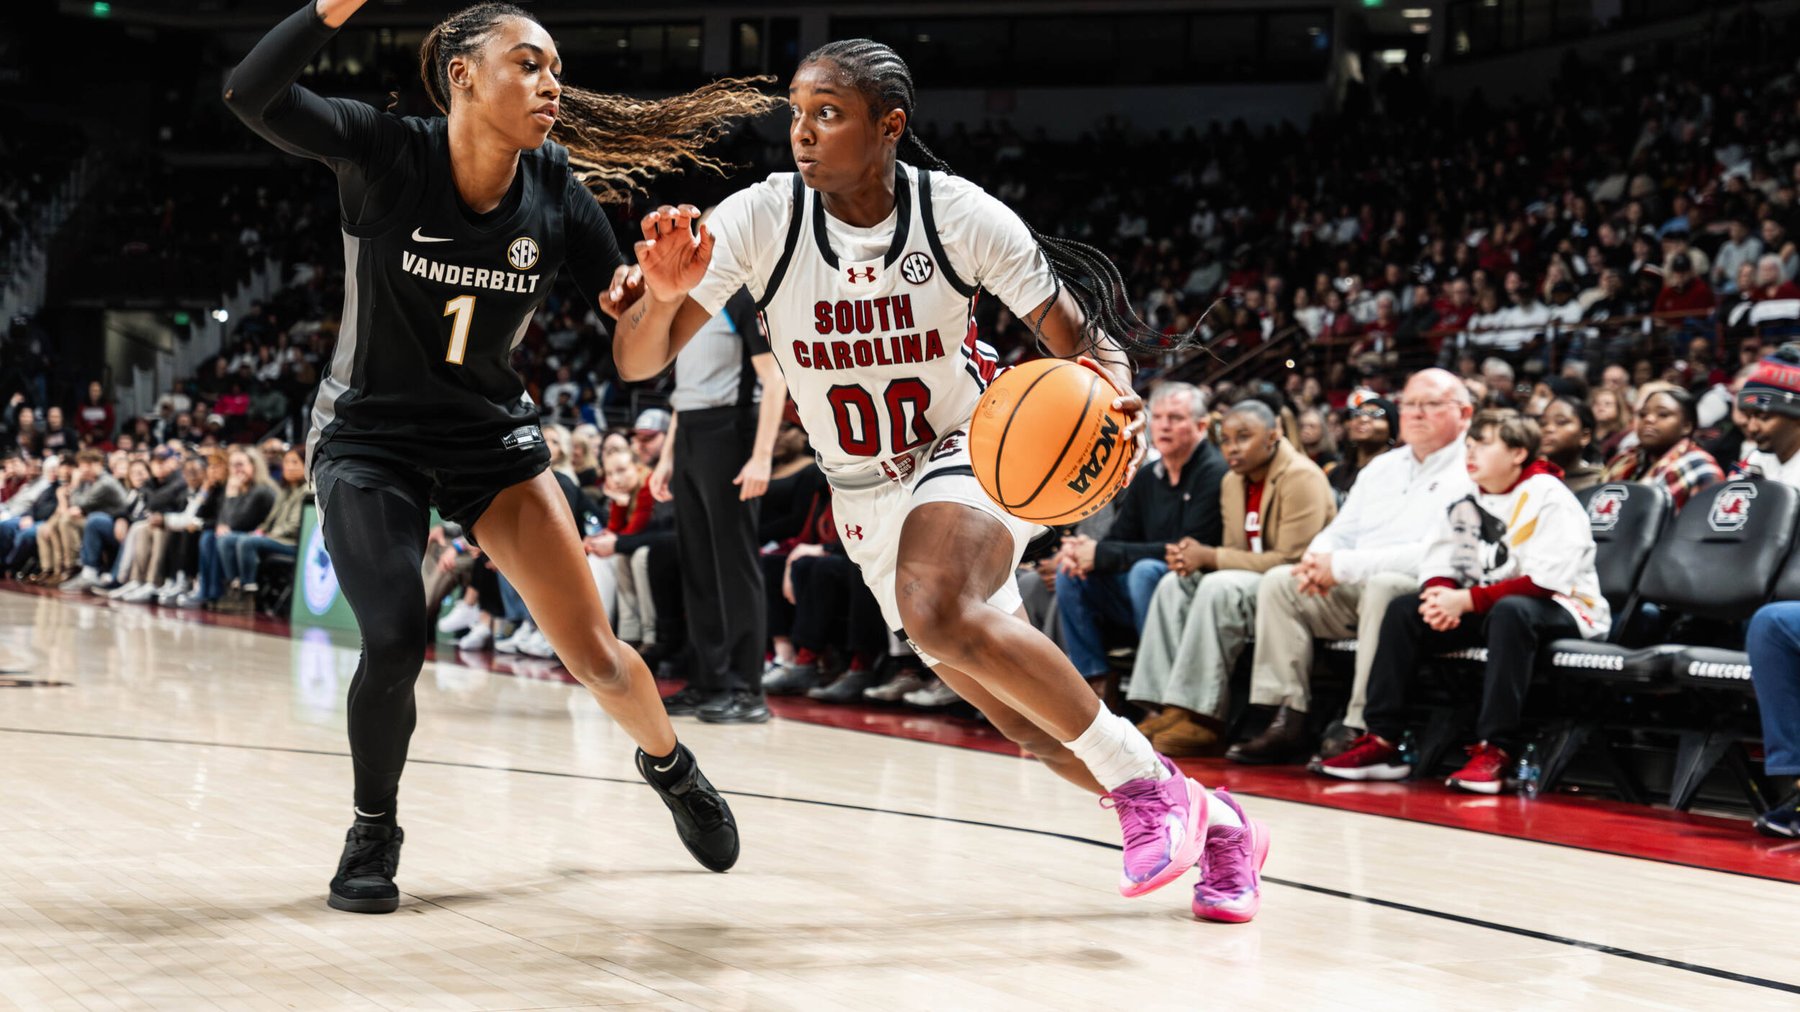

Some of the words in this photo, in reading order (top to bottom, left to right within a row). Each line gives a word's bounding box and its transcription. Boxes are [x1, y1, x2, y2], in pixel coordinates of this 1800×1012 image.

[402, 251, 540, 293] VANDERBILT
[511, 239, 536, 268] SEC
[903, 254, 932, 283] SEC
[443, 295, 476, 365] 1
[814, 294, 915, 334] SOUTH
[792, 329, 945, 370] CAROLINA
[826, 377, 937, 456] 00
[1066, 414, 1120, 495] NCAA
[1552, 652, 1624, 670] GAMECOCKS
[1688, 661, 1752, 680] GAMECOC
